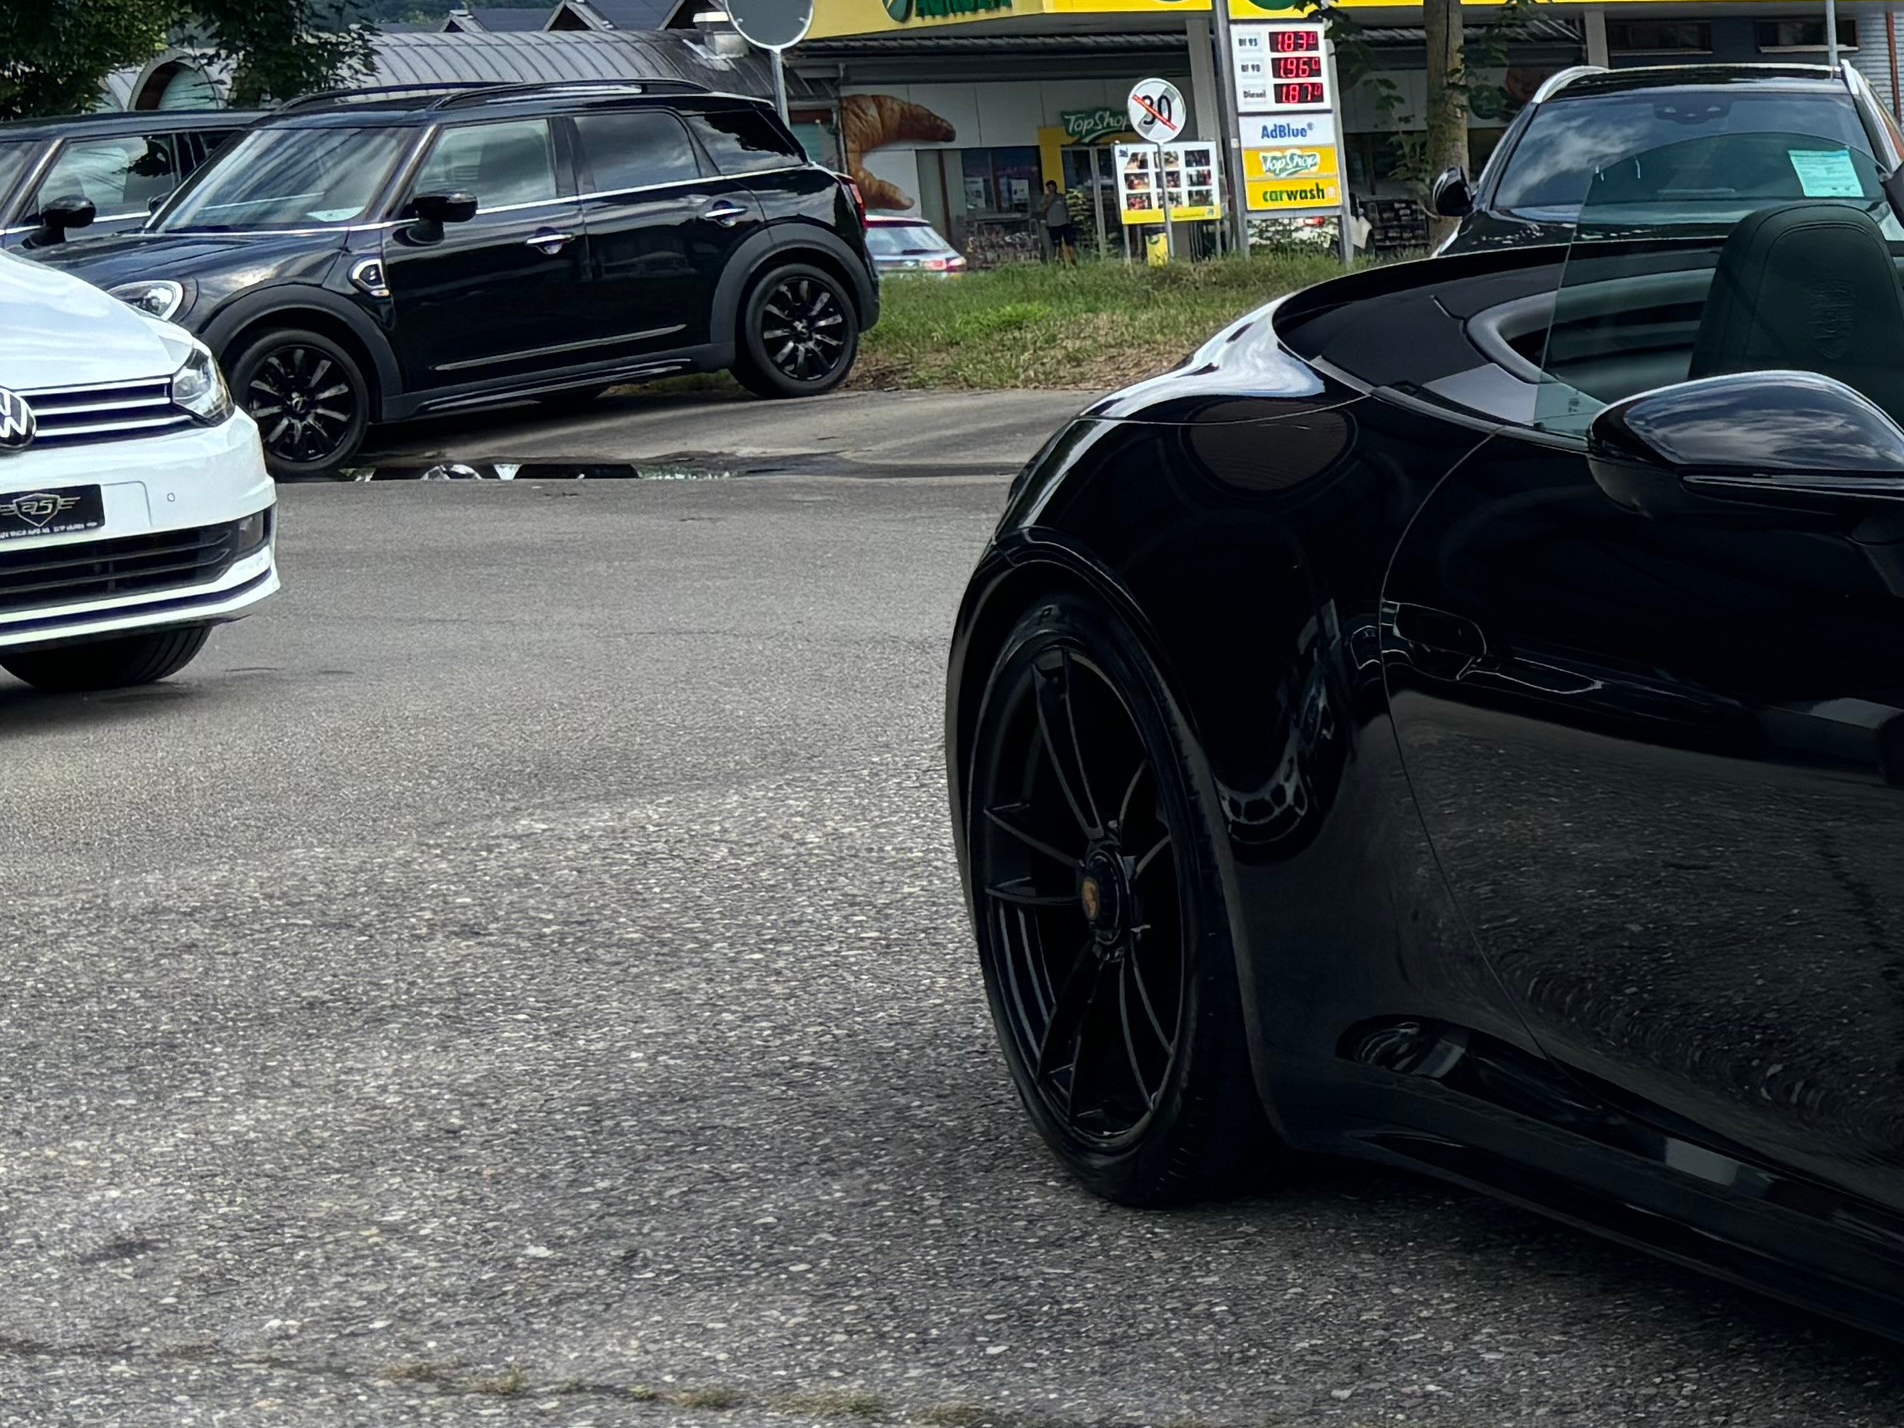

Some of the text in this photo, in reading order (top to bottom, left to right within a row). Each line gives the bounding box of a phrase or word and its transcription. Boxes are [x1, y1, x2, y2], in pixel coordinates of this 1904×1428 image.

[1243, 89, 1267, 99] Diesel
[1141, 94, 1172, 126] 30
[1263, 151, 1320, 176] TopShop
[1262, 182, 1325, 202] carwash
